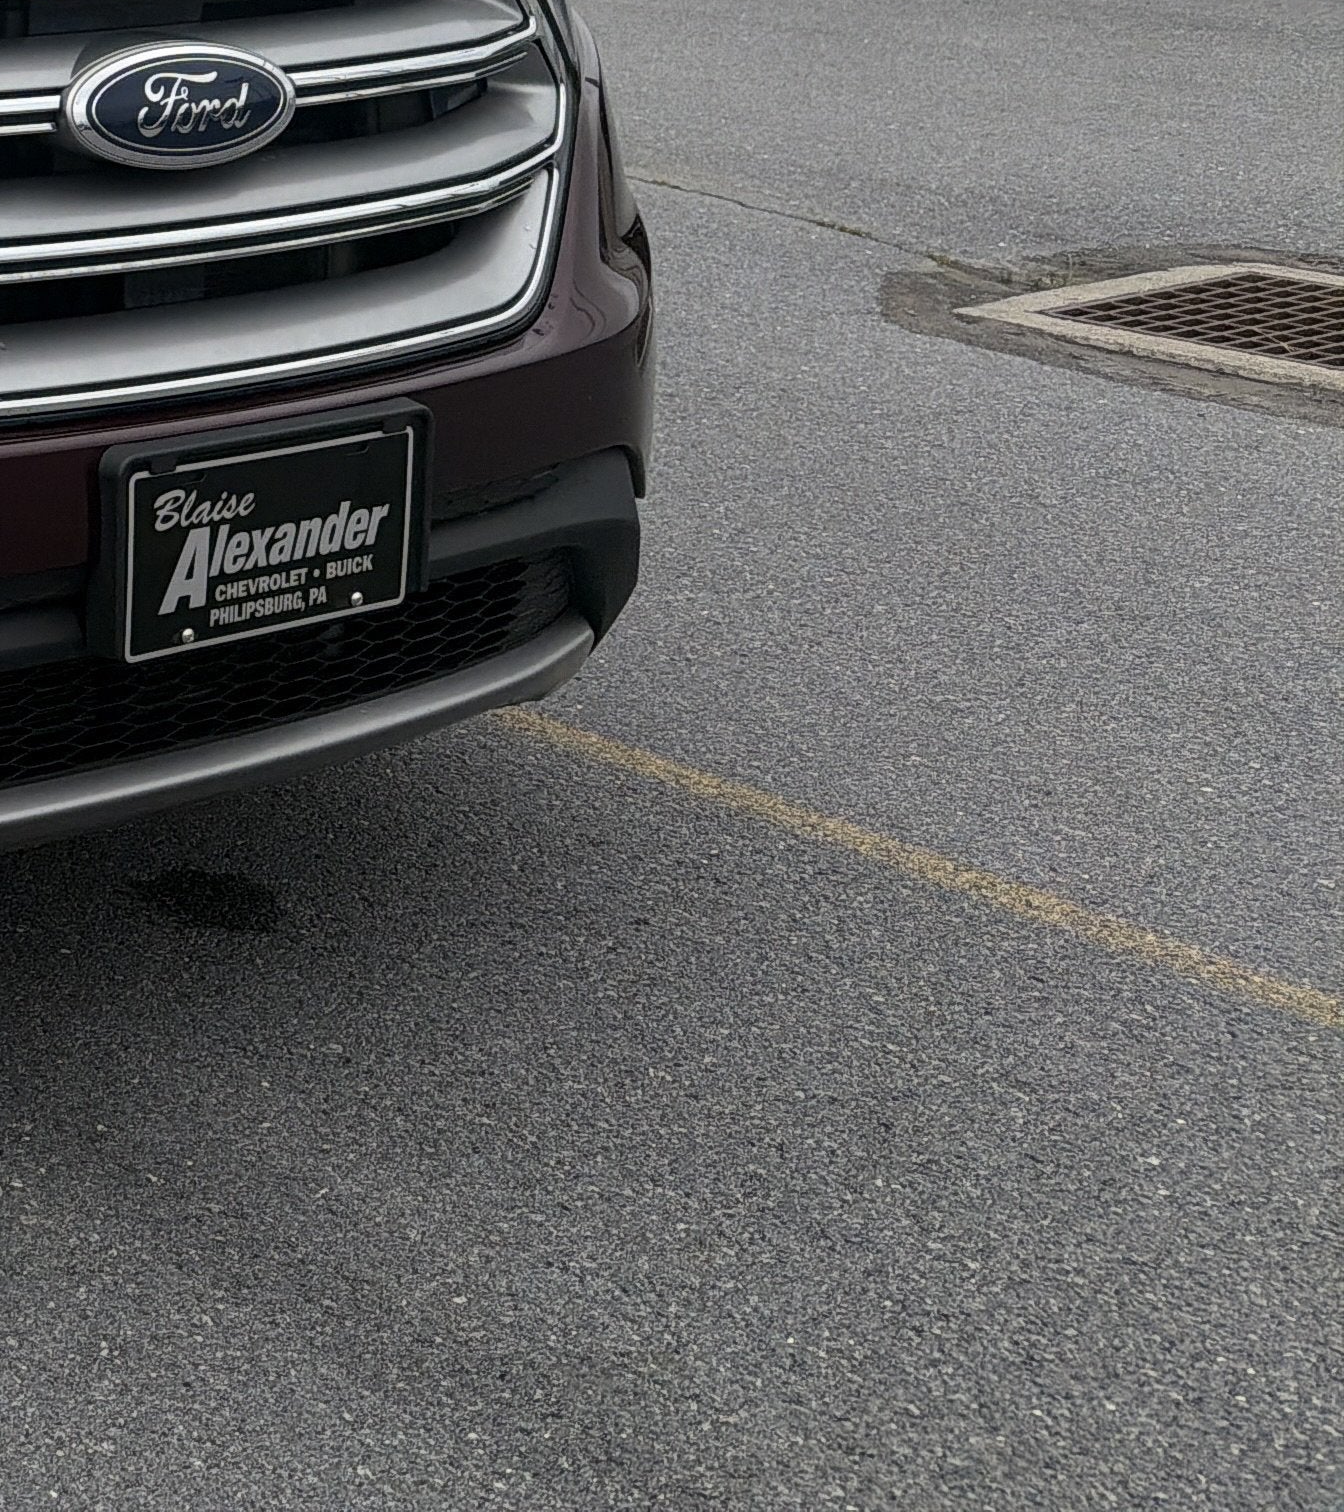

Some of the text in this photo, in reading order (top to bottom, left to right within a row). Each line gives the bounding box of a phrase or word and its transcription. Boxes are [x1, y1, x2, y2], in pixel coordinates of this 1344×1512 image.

[137, 71, 251, 138] Ford
[154, 489, 256, 532] Blaise
[158, 500, 390, 616] Alexander
[214, 554, 374, 602] CHEVROLET BUICK
[209, 585, 328, 628] PHILIPSBURG, PA
